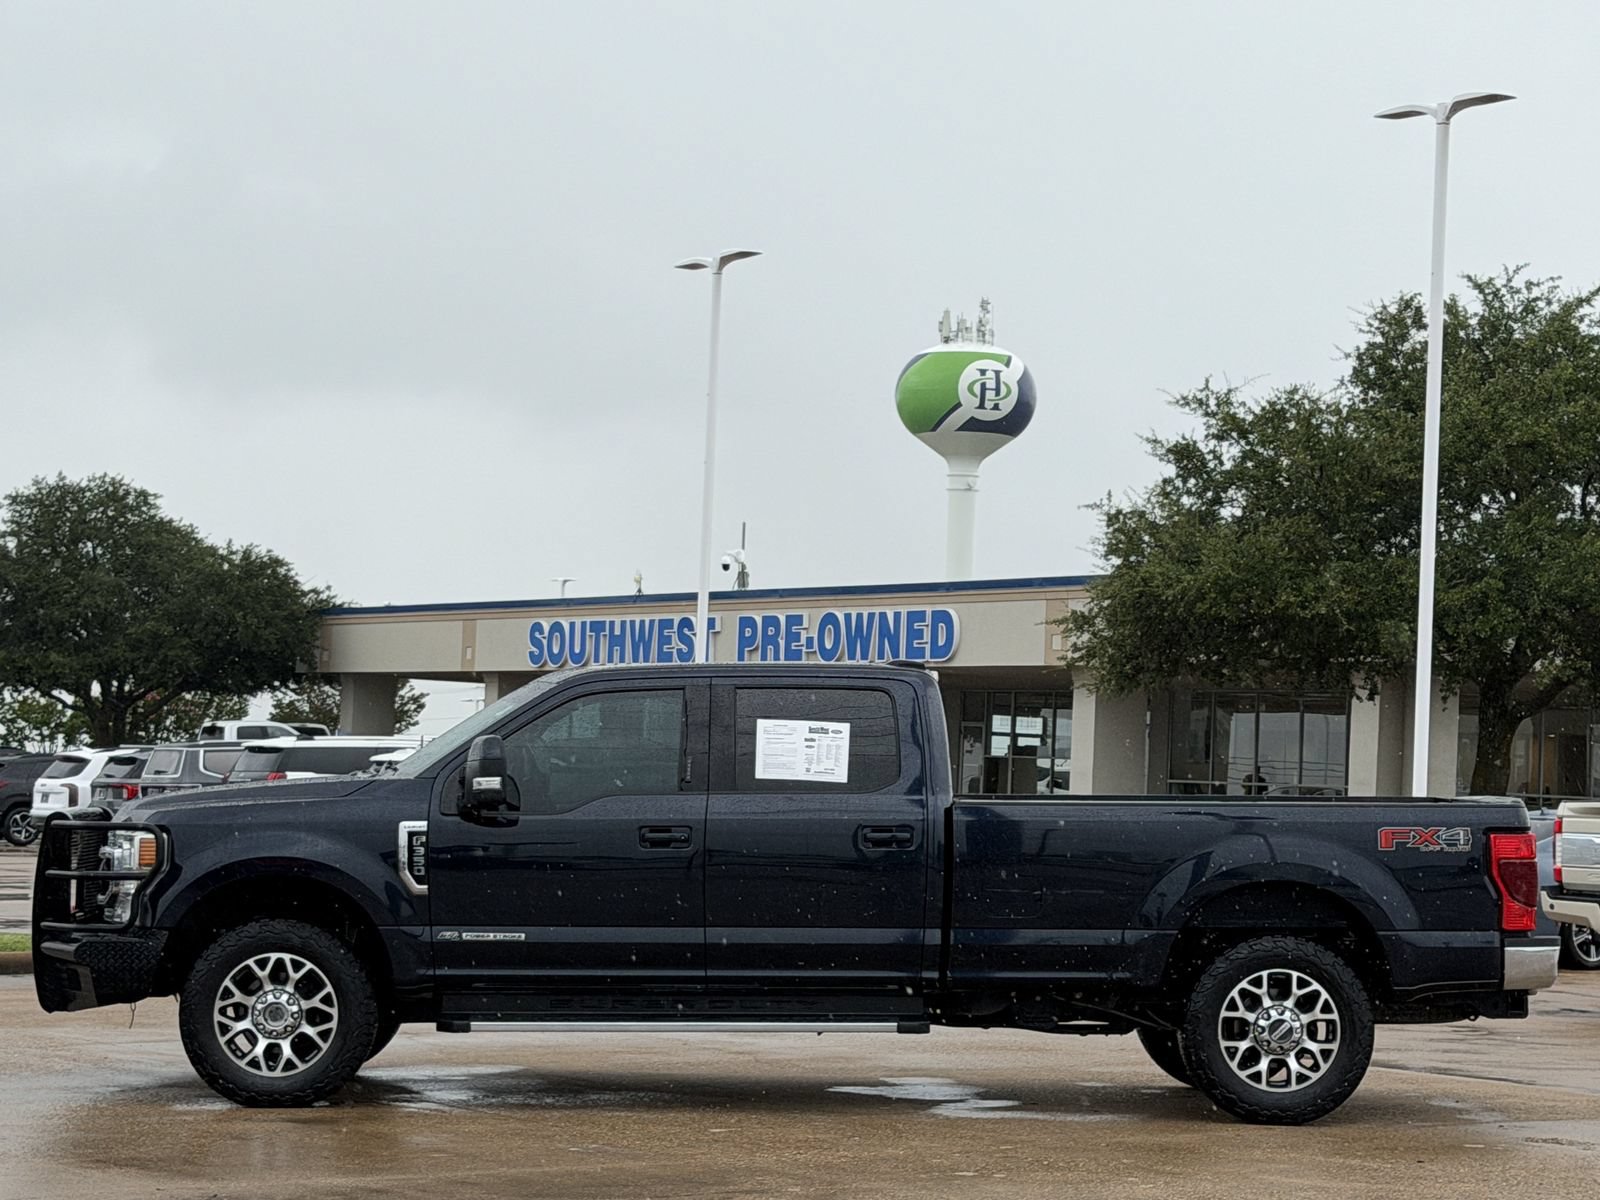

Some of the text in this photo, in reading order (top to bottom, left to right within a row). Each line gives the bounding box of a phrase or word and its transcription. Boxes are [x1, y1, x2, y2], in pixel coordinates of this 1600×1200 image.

[527, 608, 959, 668] SOUTHWEST PRE-OWNED
[1378, 827, 1473, 850] FX4
